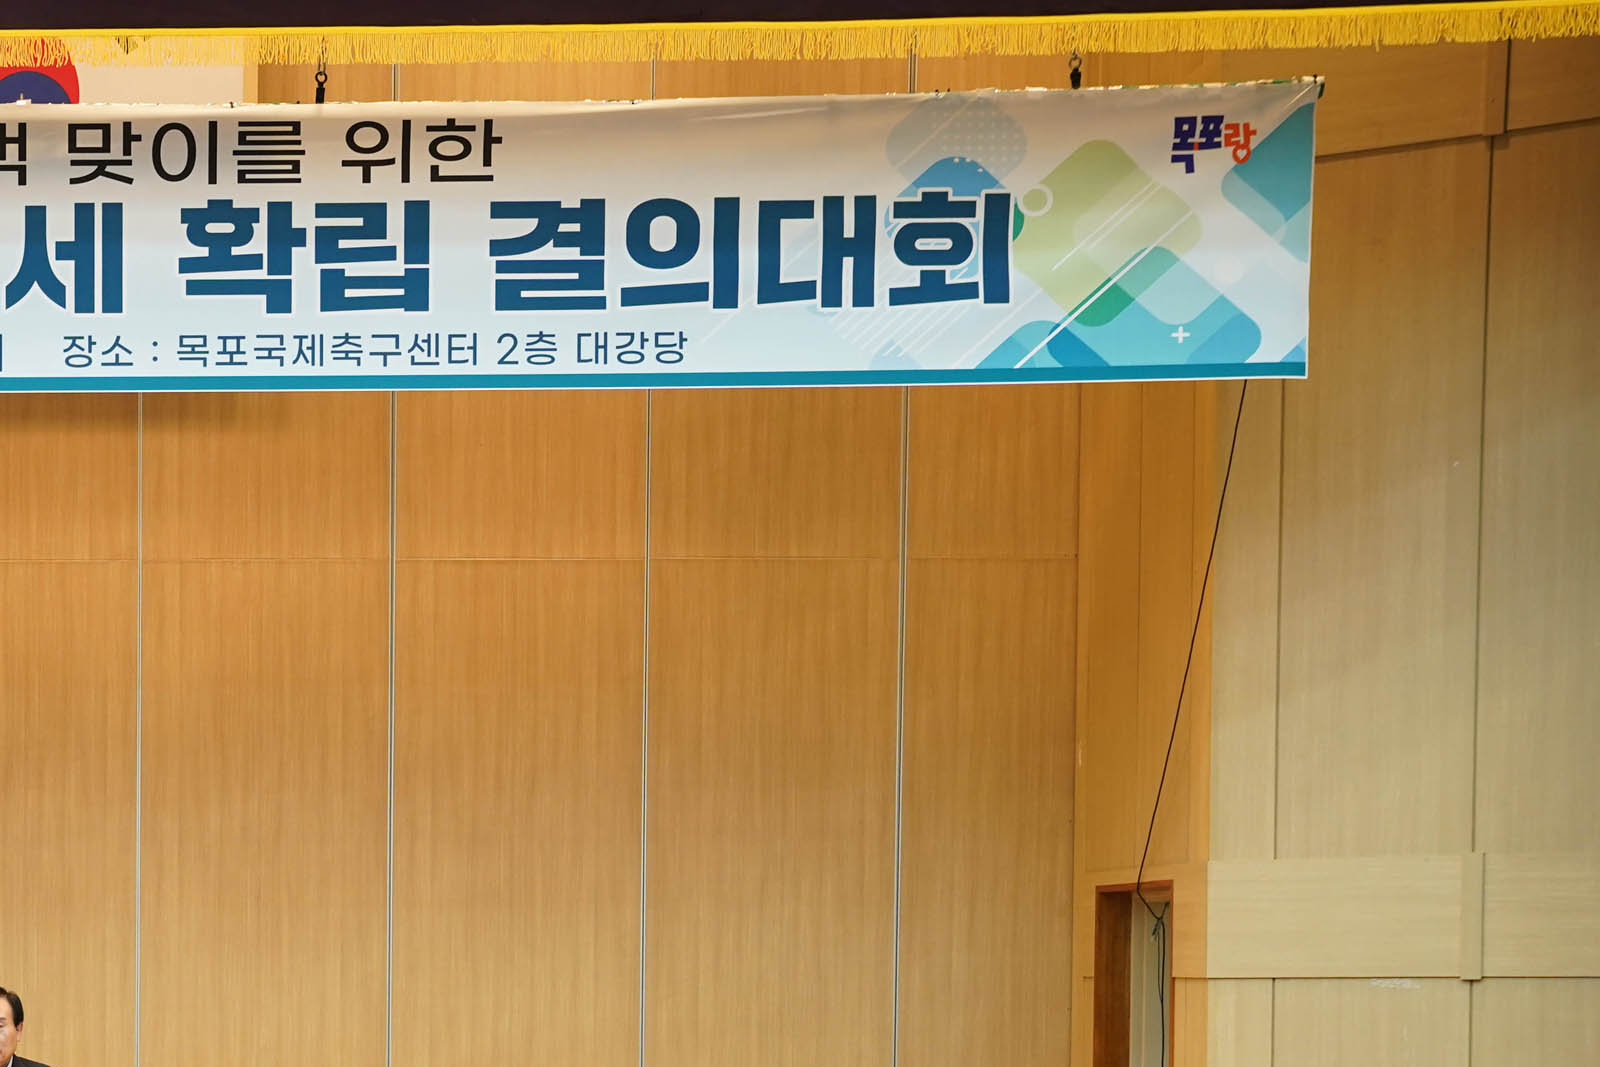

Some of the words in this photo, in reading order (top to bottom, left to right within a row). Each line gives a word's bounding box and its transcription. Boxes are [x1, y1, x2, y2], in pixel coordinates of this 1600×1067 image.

[67, 119, 306, 185] 맞이를
[341, 117, 503, 184] 위한
[1170, 114, 1258, 174] 목포랑
[177, 197, 432, 315] 확립
[488, 188, 1013, 312] 결의대회
[63, 335, 134, 368] 장소
[176, 332, 478, 368] 목포국제축구센터
[496, 330, 558, 366] 2층
[576, 329, 689, 365] 대강당
